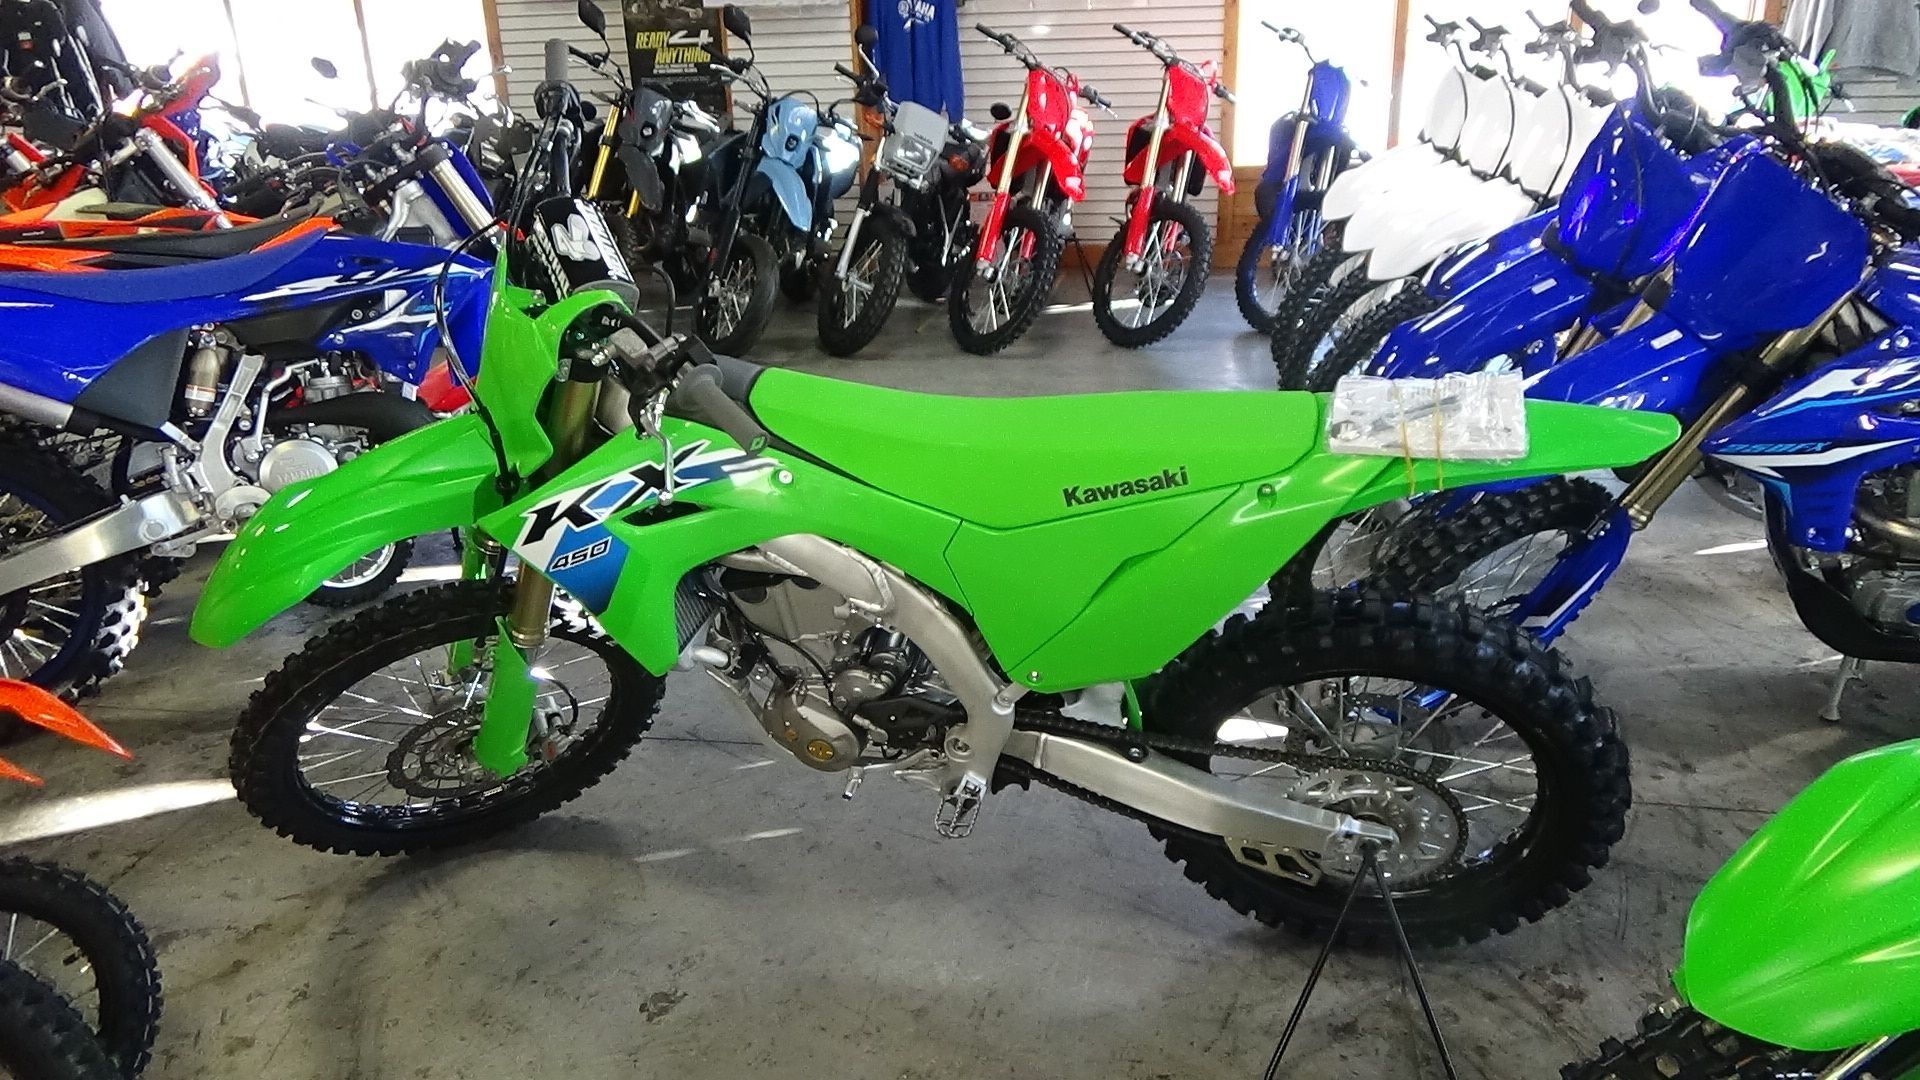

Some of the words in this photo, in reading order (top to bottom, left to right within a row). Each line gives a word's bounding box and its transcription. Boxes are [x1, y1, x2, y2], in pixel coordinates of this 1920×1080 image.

[635, 30, 671, 49] READY
[655, 46, 711, 64] ANYTHING
[1062, 465, 1189, 508] Kawasaki
[550, 537, 613, 572] 450
